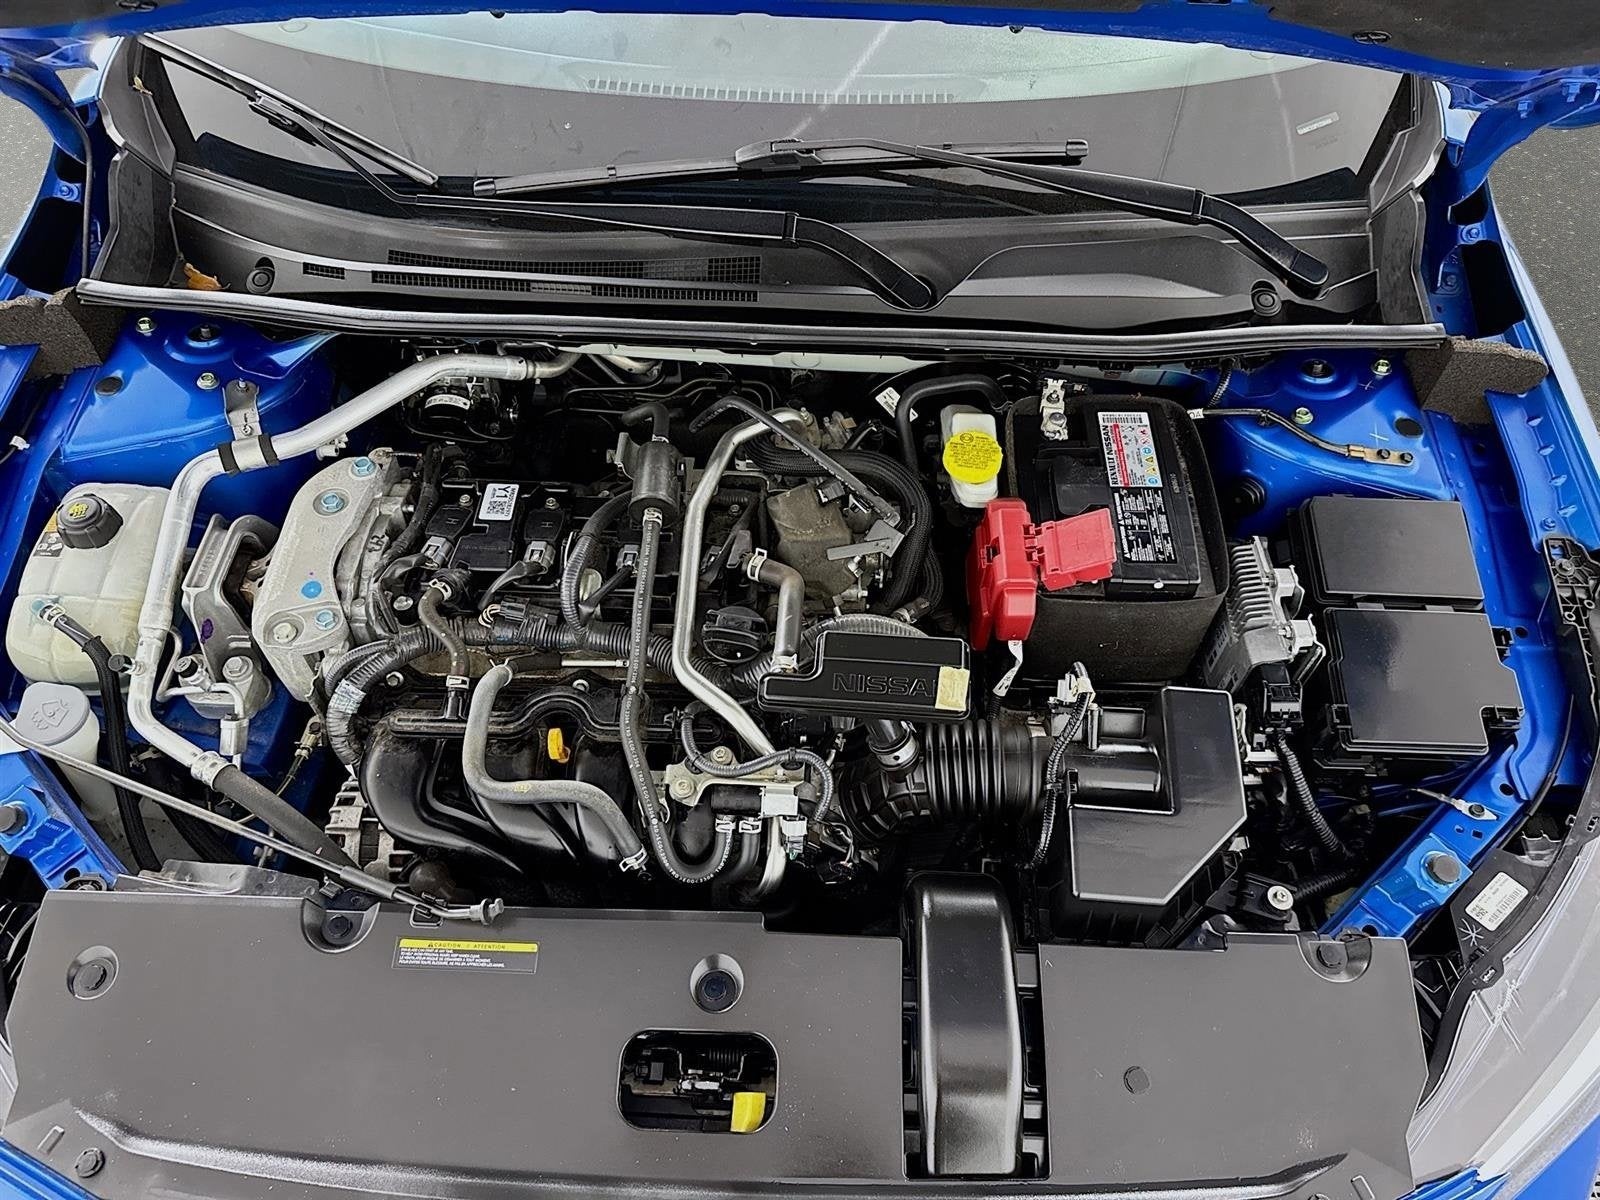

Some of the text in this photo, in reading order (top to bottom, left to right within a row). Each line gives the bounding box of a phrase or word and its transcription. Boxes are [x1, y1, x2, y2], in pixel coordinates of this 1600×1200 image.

[1101, 424, 1114, 454] NISSAN
[1106, 454, 1119, 485] RENAULT
[496, 486, 511, 498] Y1
[832, 672, 936, 698] NISSA
